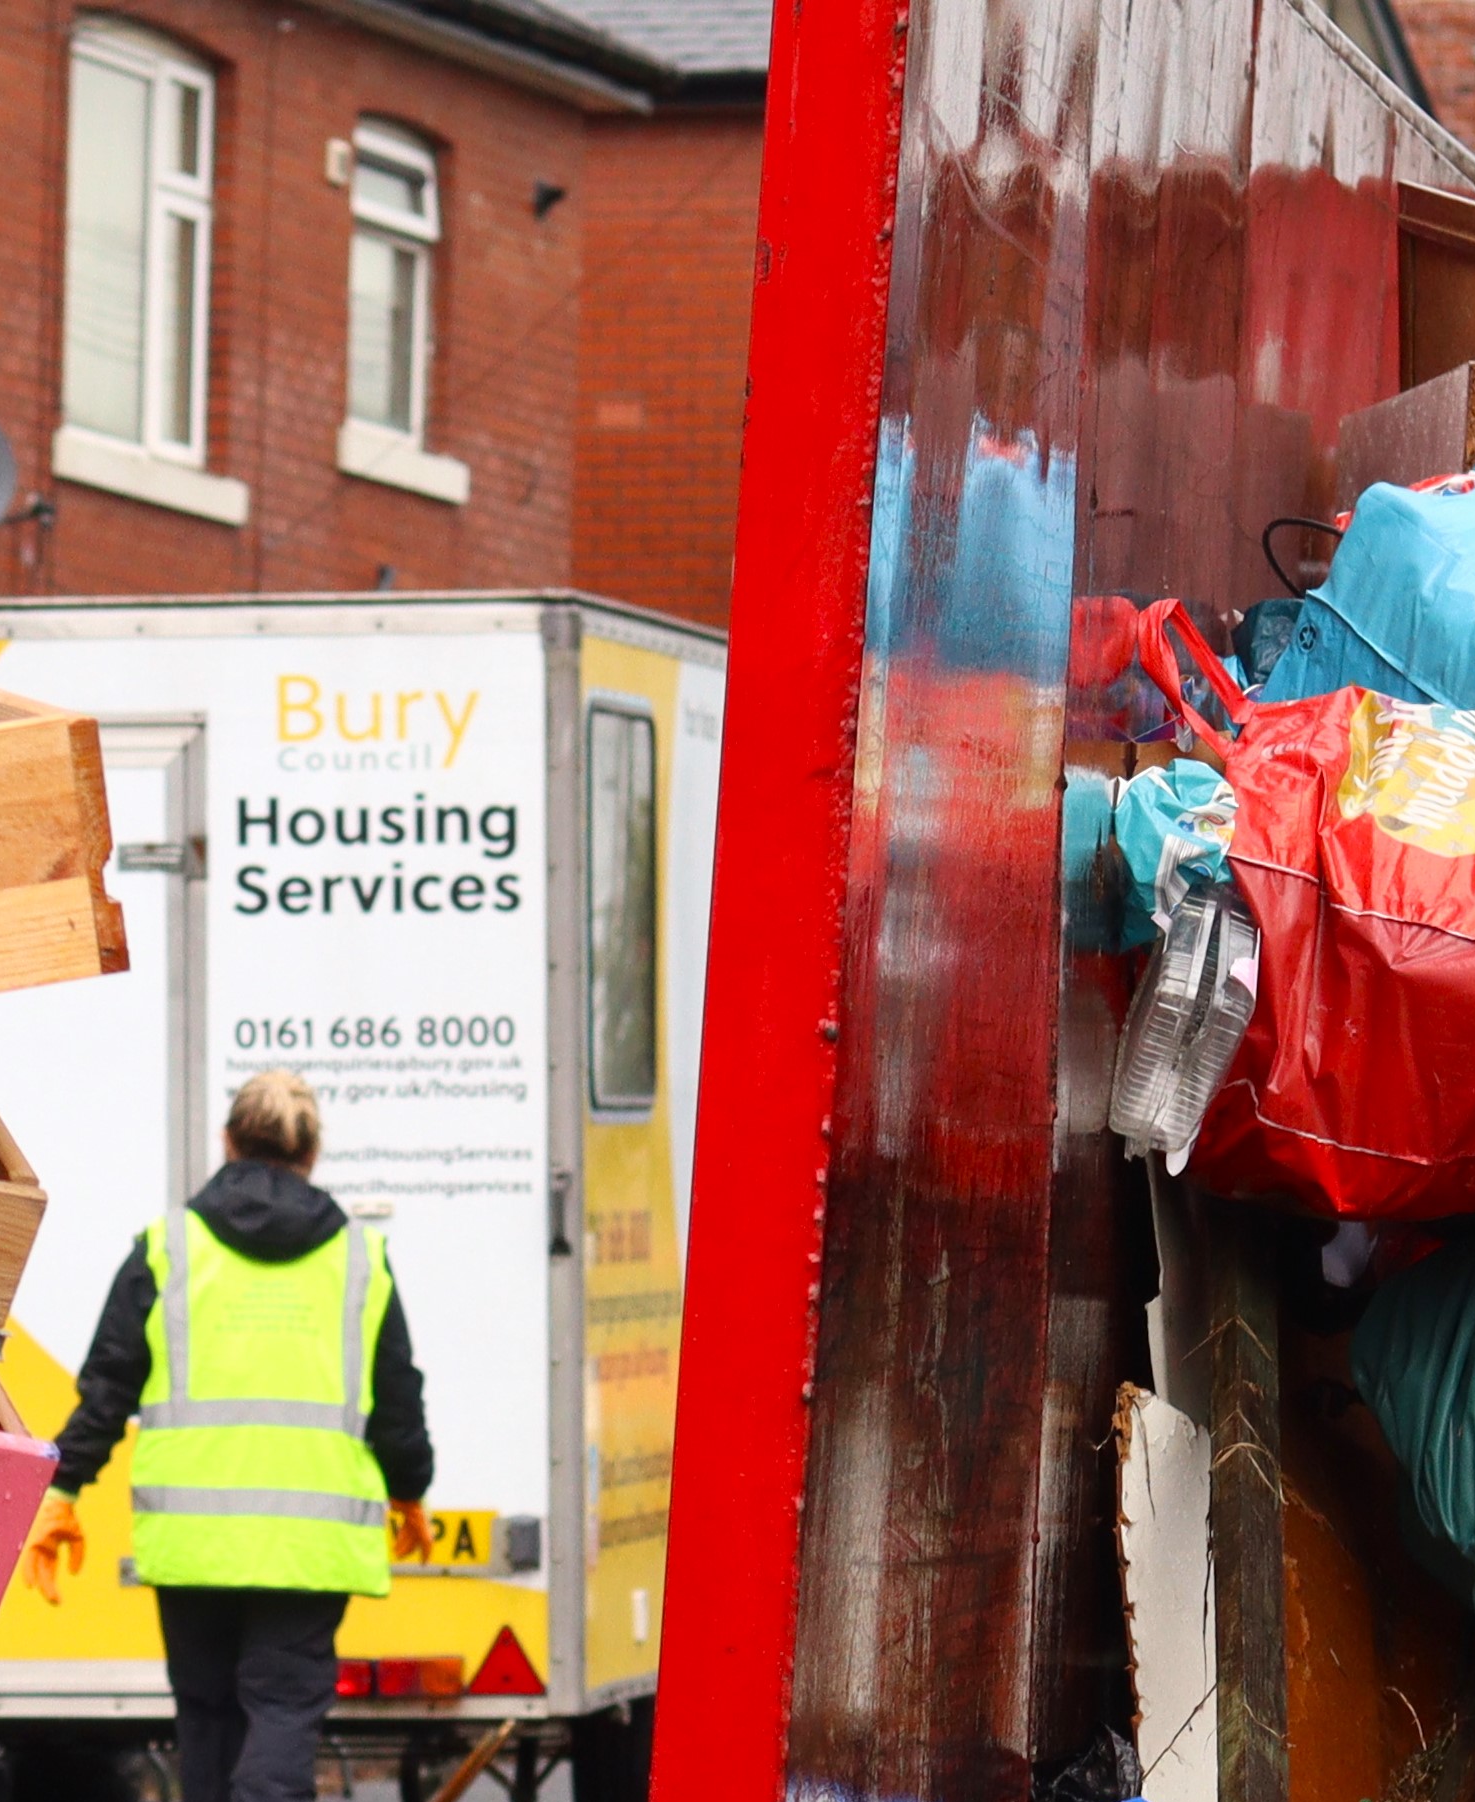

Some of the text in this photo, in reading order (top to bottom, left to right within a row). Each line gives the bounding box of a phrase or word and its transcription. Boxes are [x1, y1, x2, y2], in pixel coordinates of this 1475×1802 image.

[276, 675, 480, 768] Bury
[277, 745, 433, 772] Council
[236, 793, 519, 859] Housing
[234, 862, 522, 915] Services
[235, 1015, 516, 1049] 0161 686 8000
